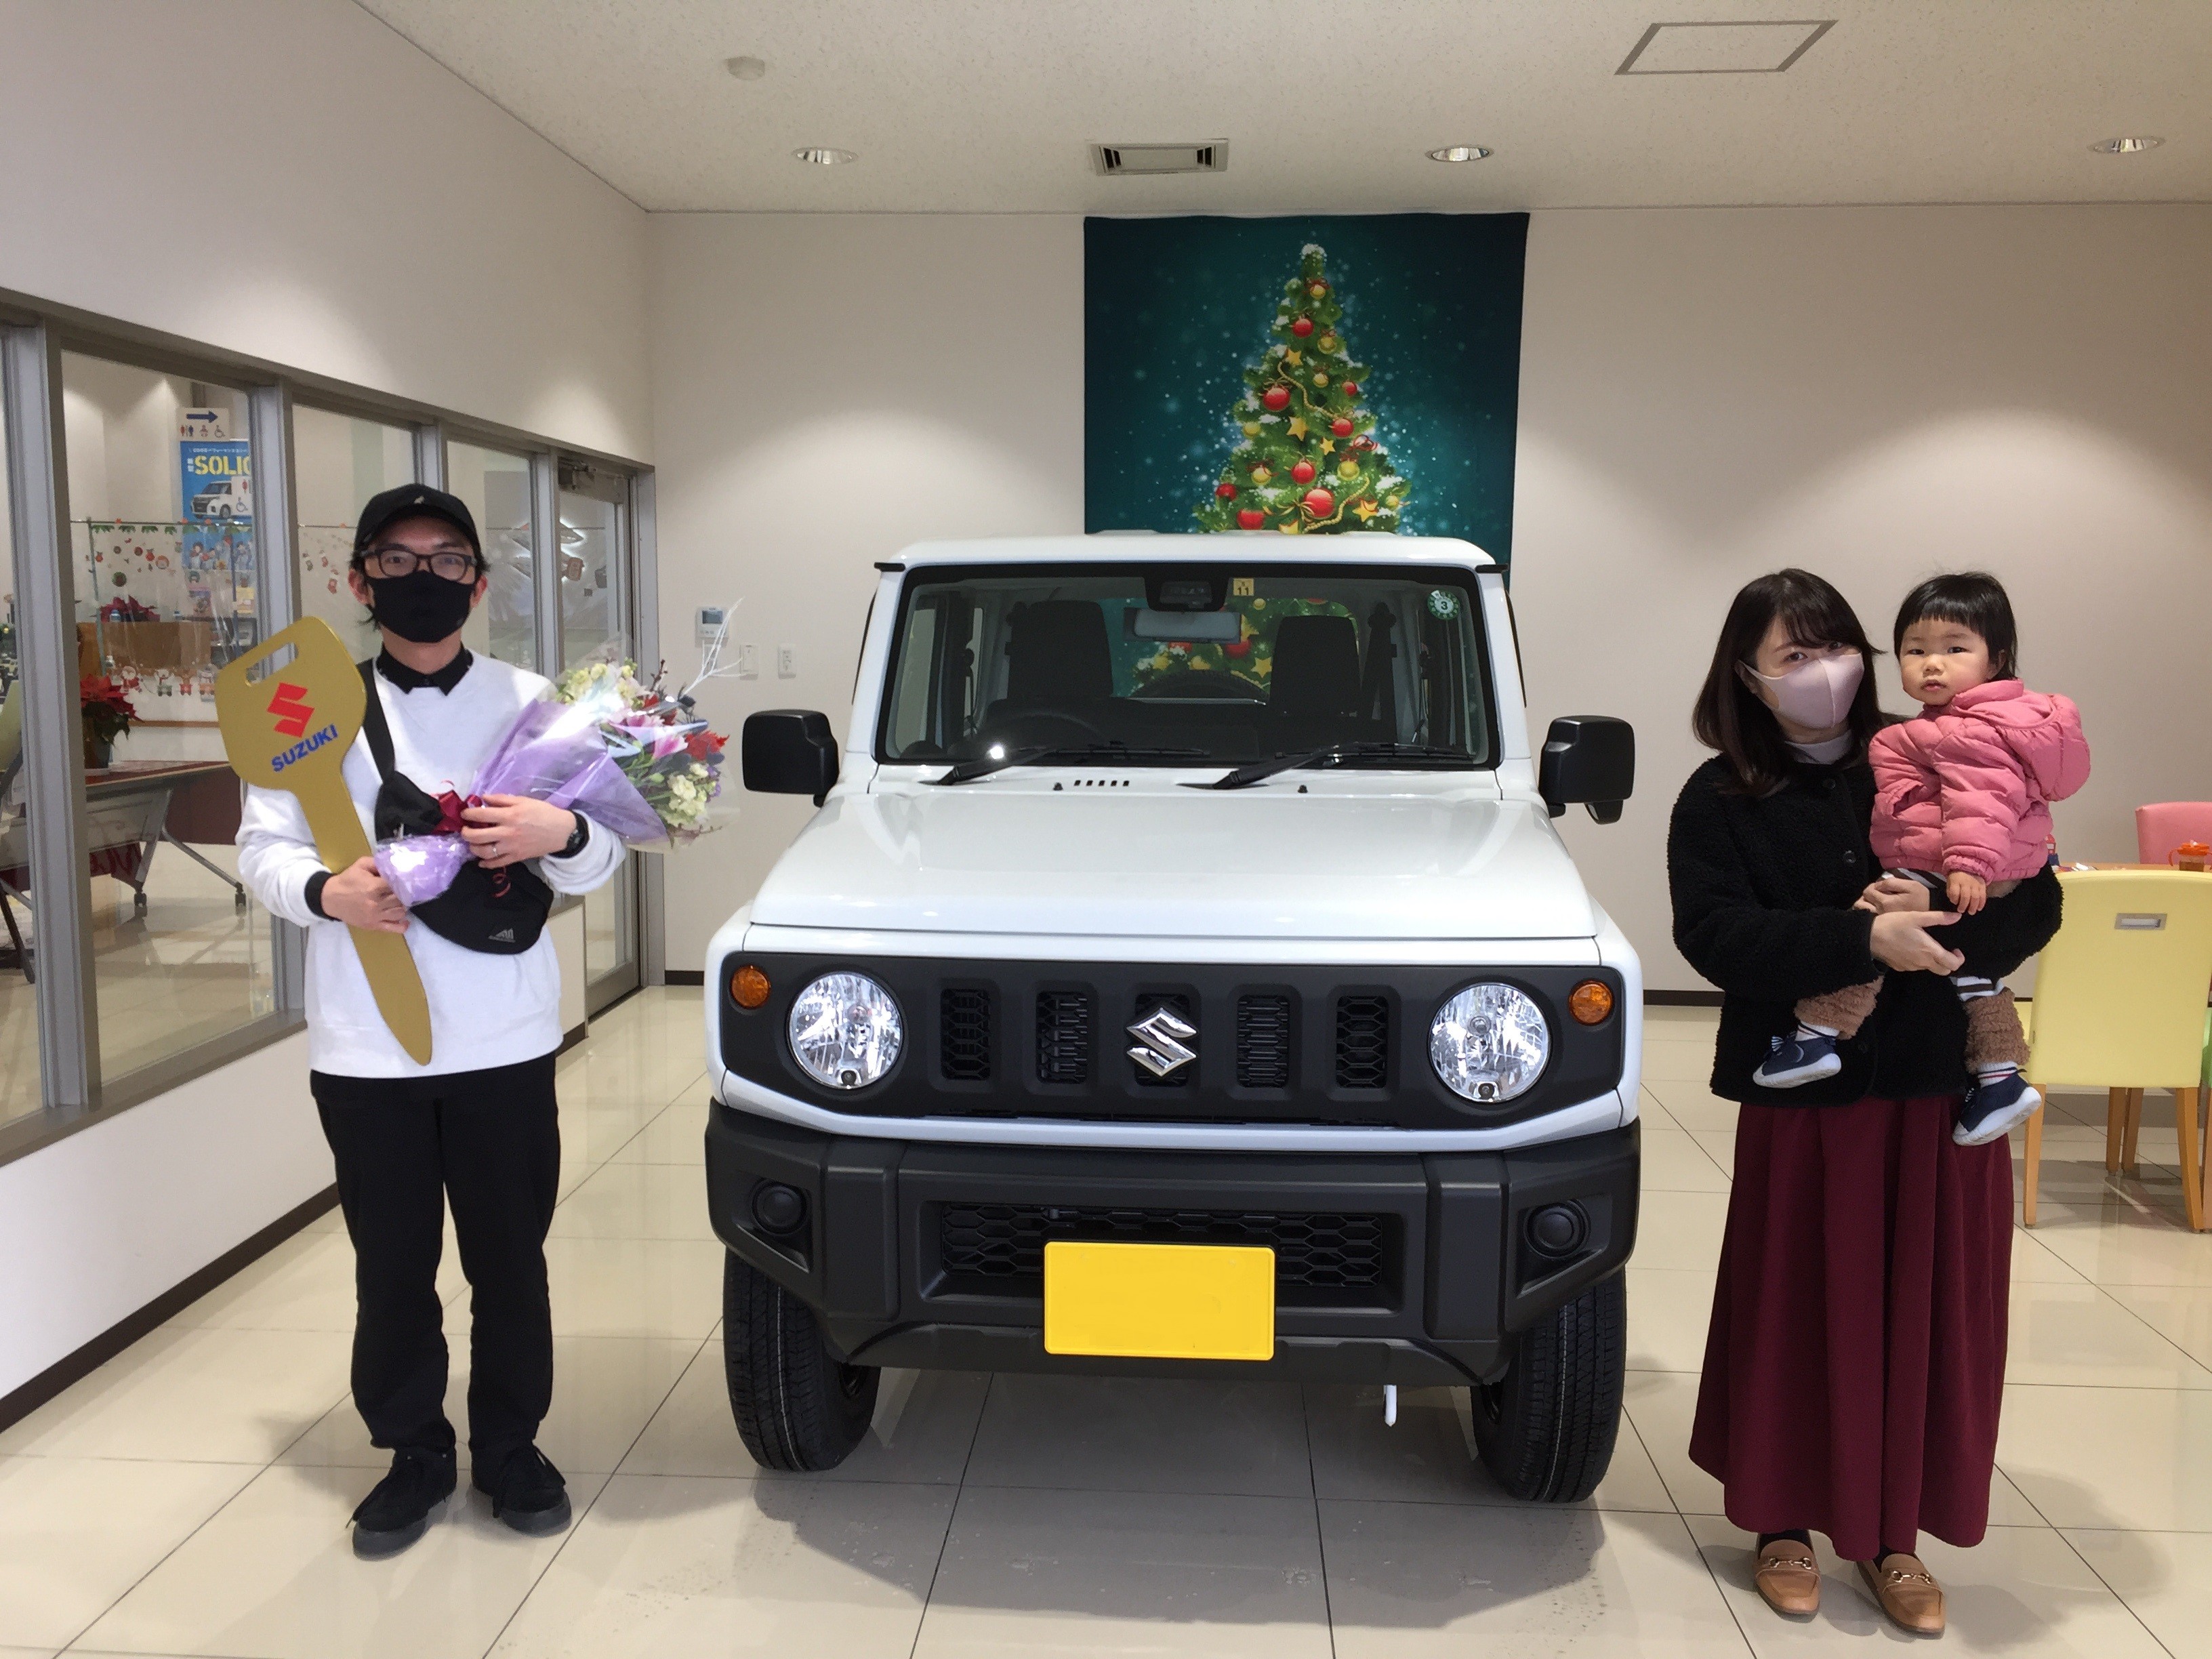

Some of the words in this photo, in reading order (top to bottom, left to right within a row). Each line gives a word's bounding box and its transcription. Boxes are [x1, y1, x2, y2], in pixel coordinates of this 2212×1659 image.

[1237, 587, 1249, 595] 11
[1441, 601, 1448, 610] 3
[271, 723, 338, 773] SUZUKI
